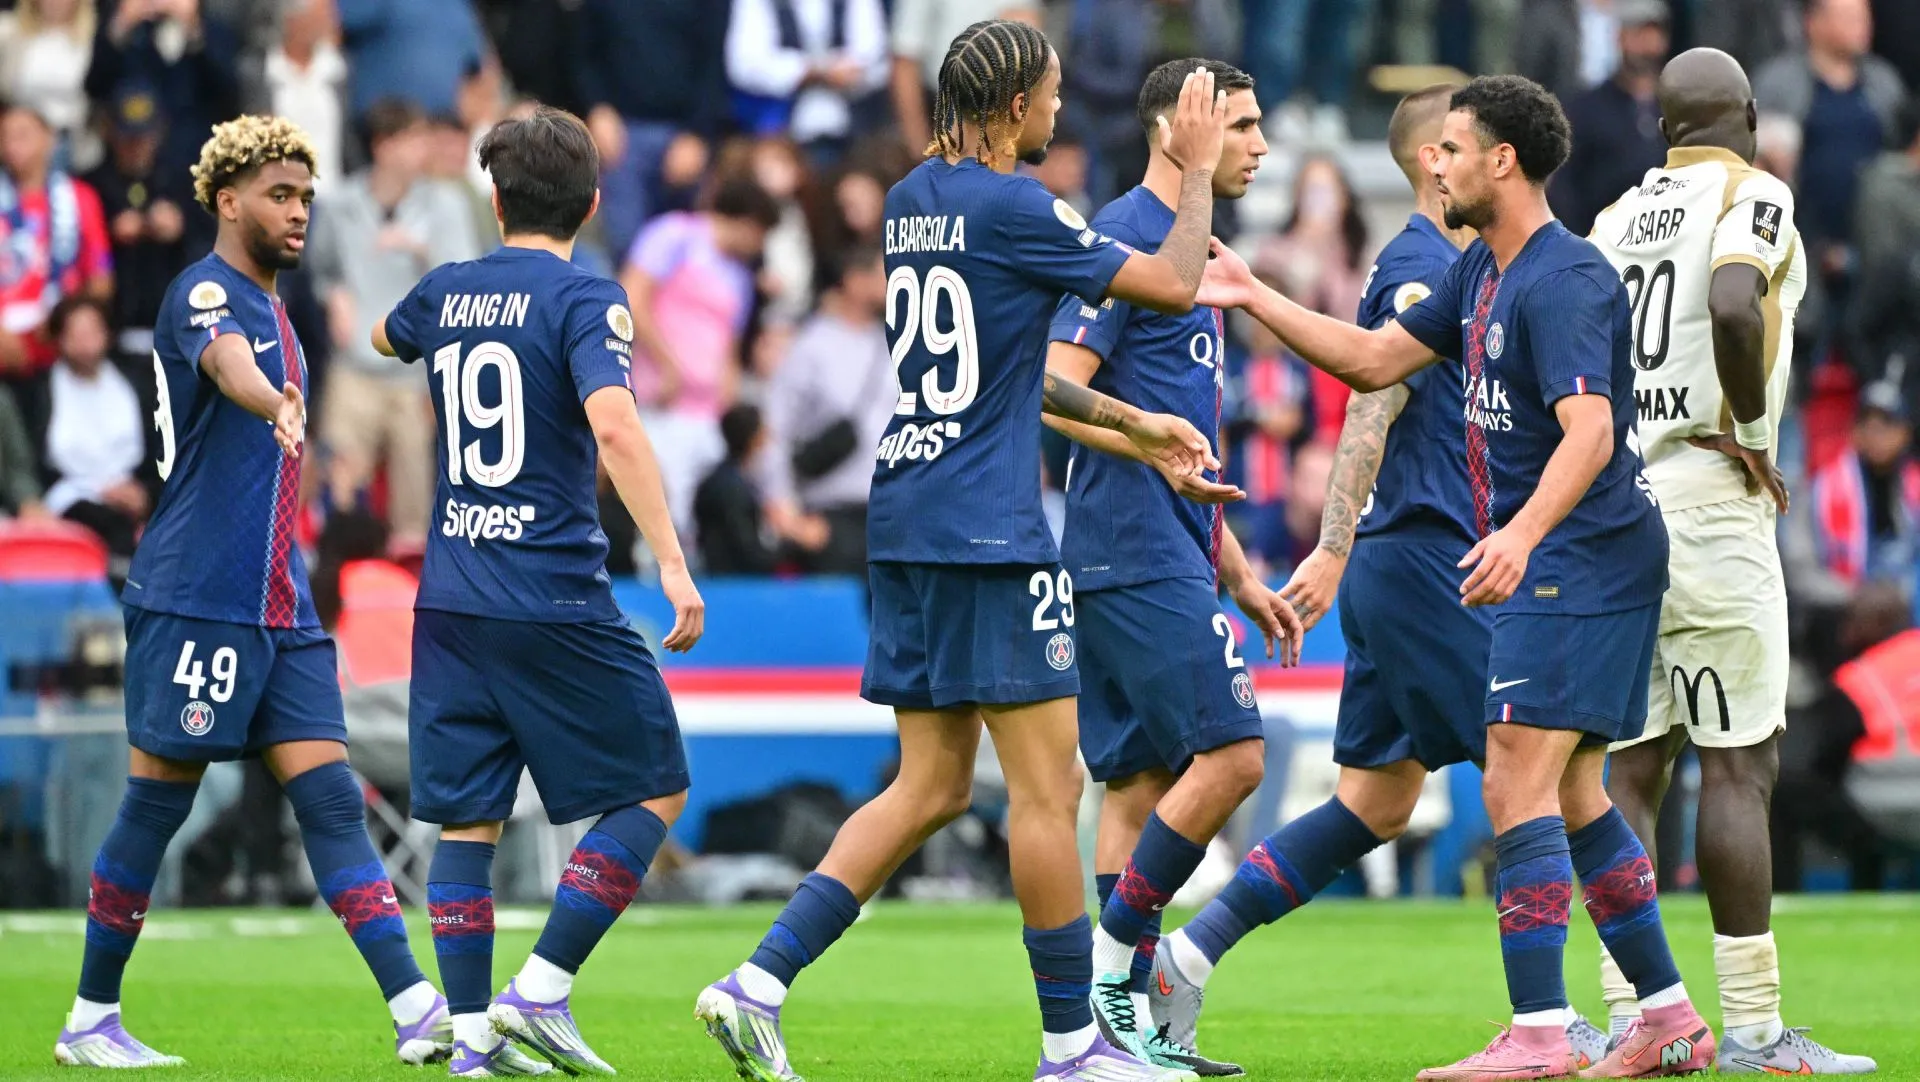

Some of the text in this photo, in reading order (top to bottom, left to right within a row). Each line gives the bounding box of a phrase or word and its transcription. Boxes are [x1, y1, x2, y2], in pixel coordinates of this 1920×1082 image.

[886, 215, 966, 255] B.BARCOLA
[1616, 207, 1686, 247] M.SARR
[439, 292, 531, 328] KANG IN
[886, 265, 980, 416] 29
[433, 341, 526, 488] 19
[1029, 568, 1075, 631] 29
[1212, 613, 1245, 668] 2
[173, 640, 238, 703] 49
